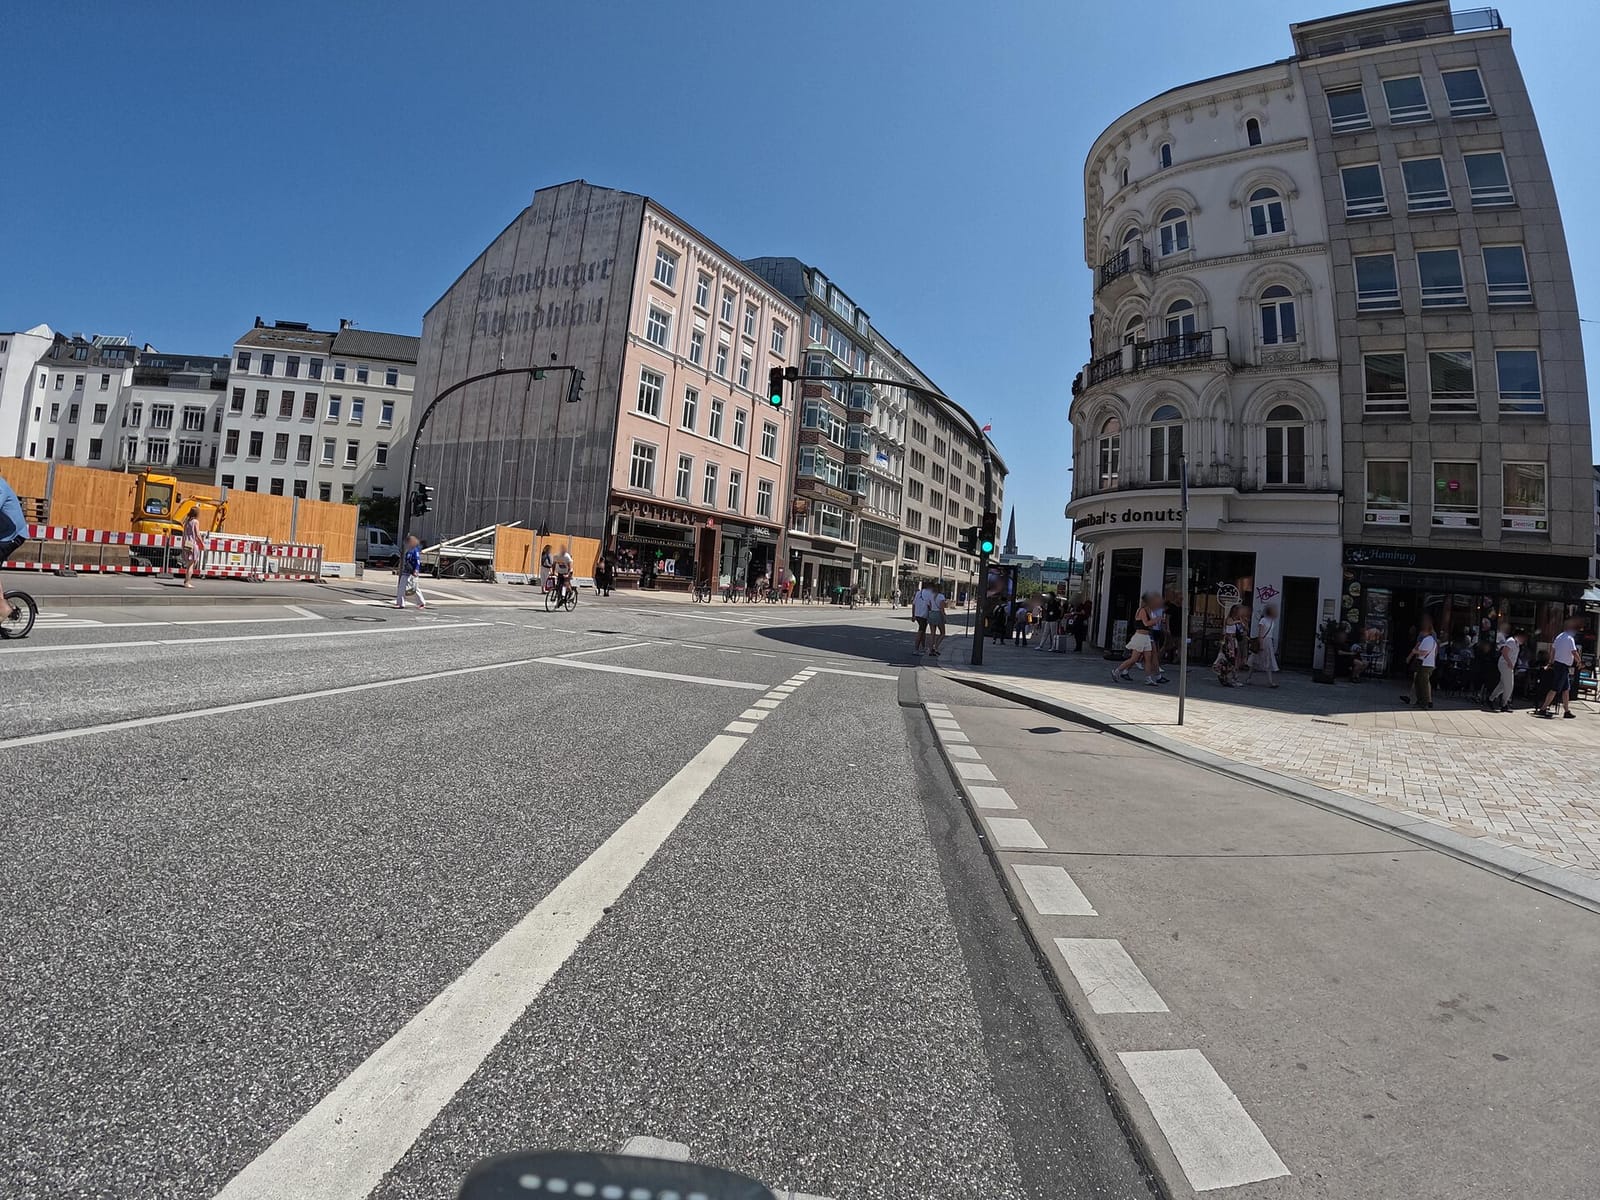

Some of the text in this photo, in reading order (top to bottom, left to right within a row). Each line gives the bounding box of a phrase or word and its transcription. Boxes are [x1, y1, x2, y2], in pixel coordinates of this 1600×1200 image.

[478, 256, 615, 302] Hamburger
[620, 500, 697, 523] APOTHEKE
[1122, 508, 1182, 523] donuts
[1370, 549, 1417, 566] Hamburg
